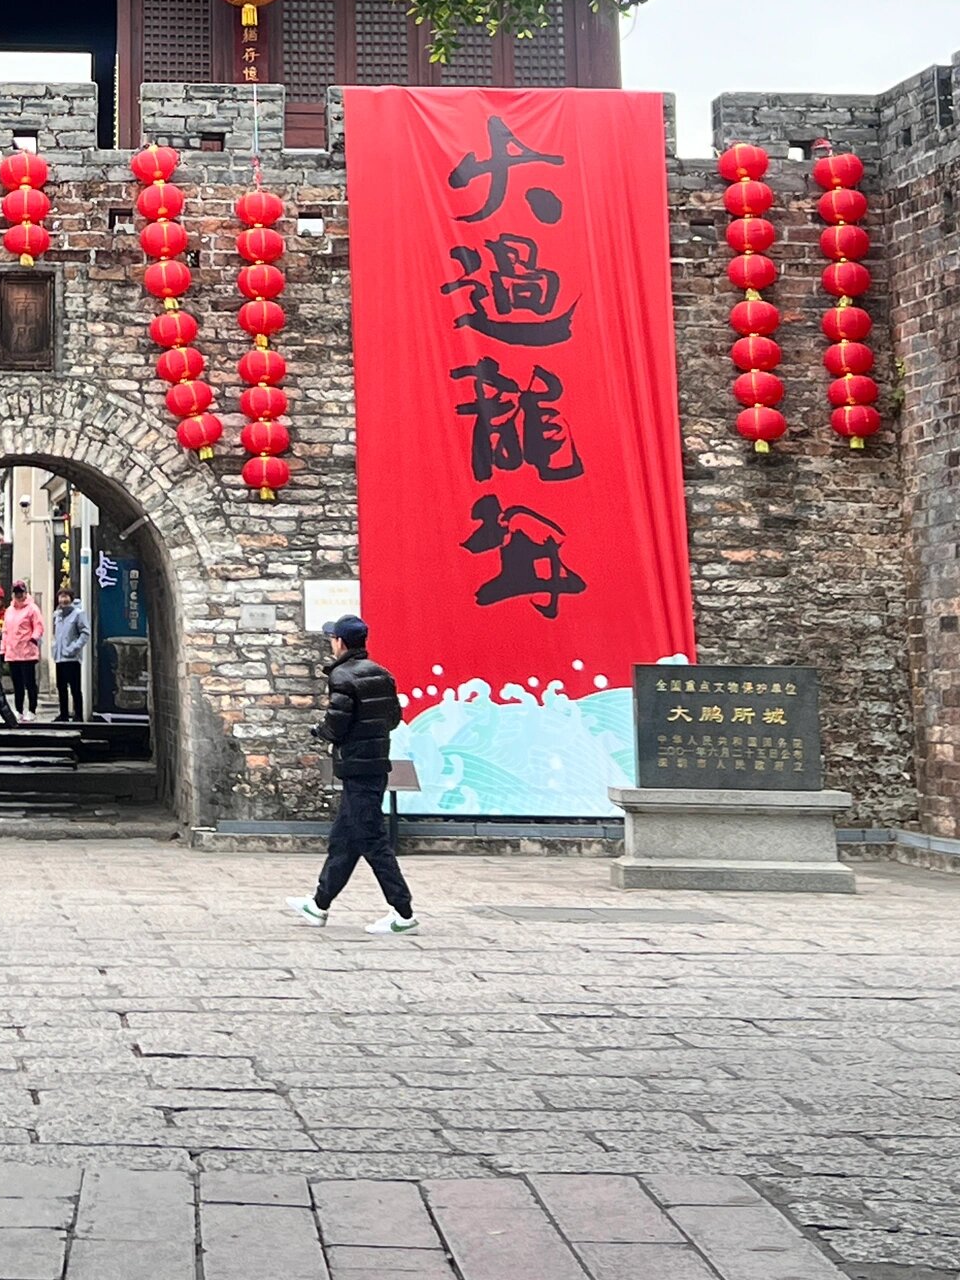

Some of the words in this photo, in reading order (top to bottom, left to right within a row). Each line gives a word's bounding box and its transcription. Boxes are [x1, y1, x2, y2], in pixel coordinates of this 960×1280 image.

[655, 678, 799, 696] 全国重点文物保护单位
